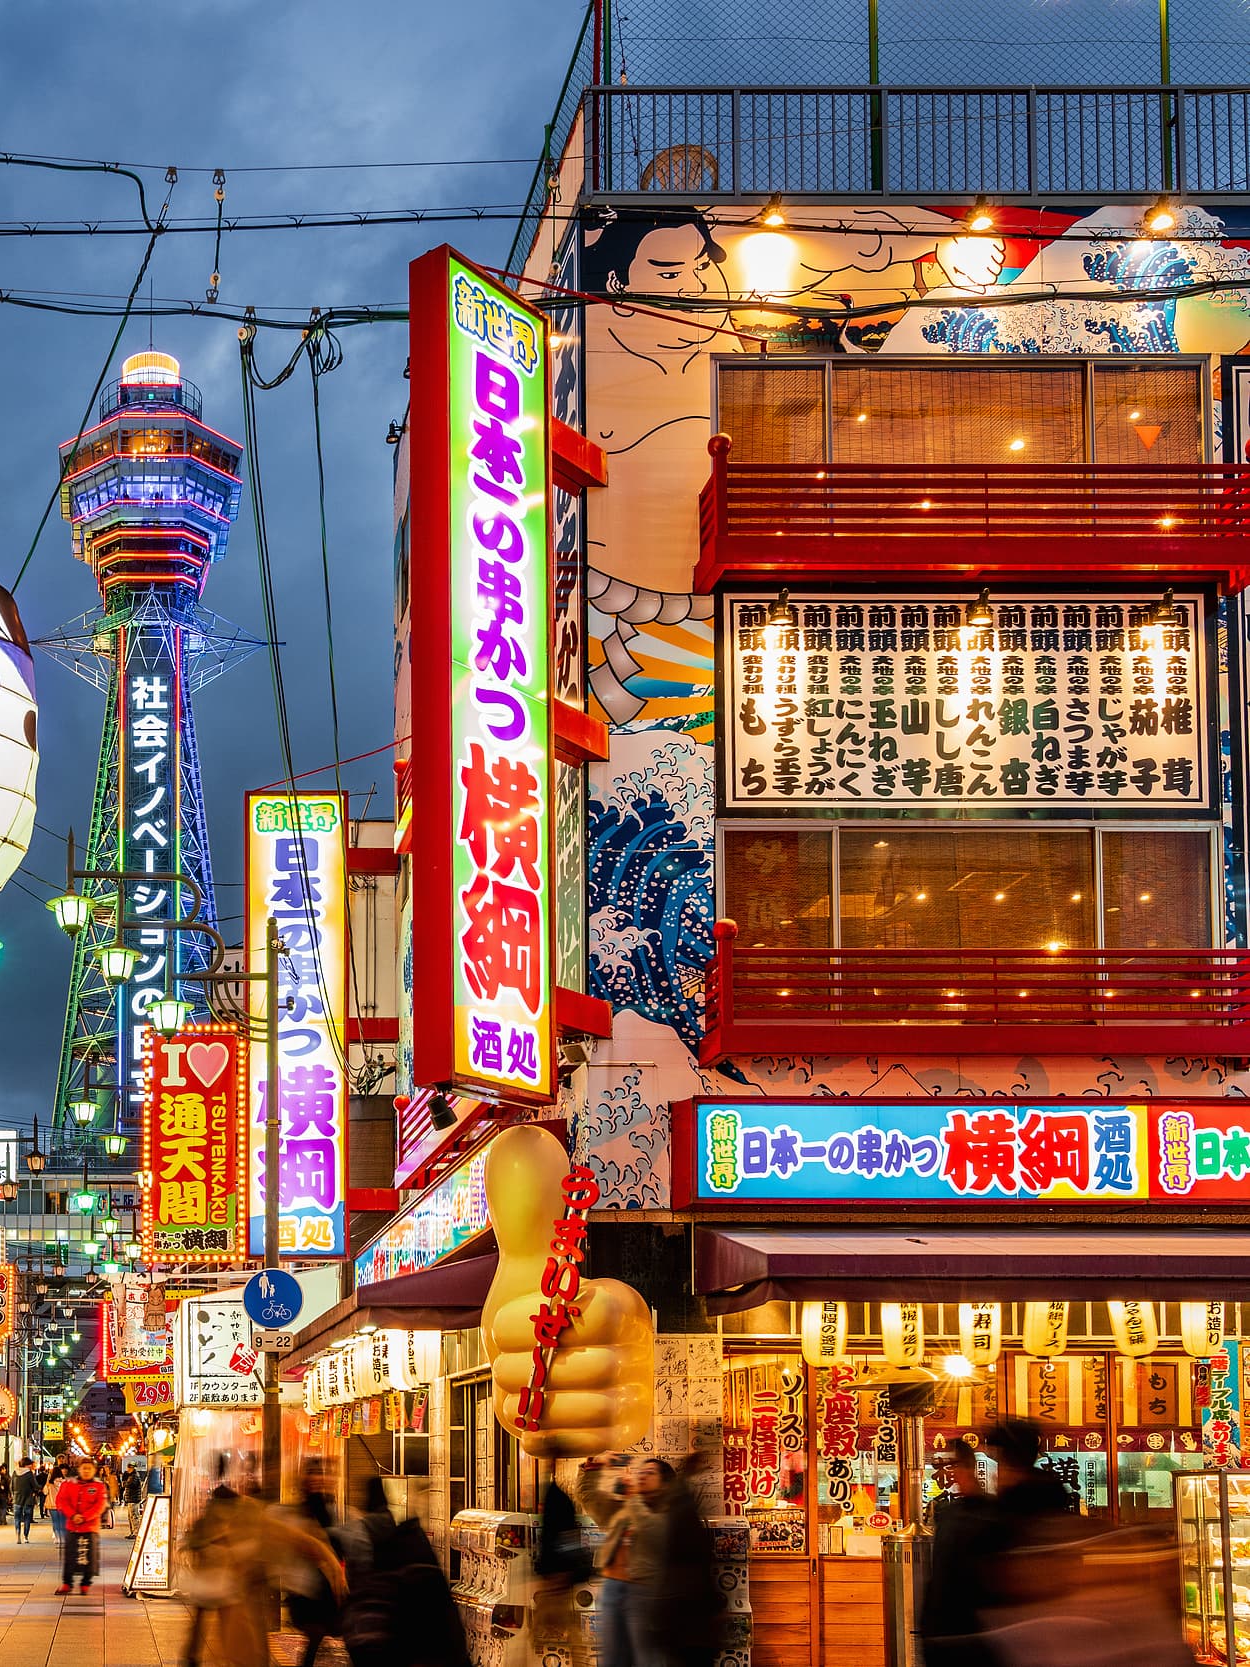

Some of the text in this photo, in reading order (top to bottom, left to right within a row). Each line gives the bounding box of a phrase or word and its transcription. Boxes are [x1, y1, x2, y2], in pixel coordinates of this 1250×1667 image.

[455, 276, 538, 371] 新世界
[471, 352, 528, 741] 日本一の串かつ
[256, 802, 337, 832] 新世界
[460, 742, 541, 1015] 横綱
[160, 1043, 187, 1087] I
[472, 1015, 537, 1080] 酒処
[159, 1092, 207, 1225] 通天閣
[210, 1092, 227, 1224] TSUTENKAKU
[710, 1114, 738, 1189] 新世界
[742, 1128, 937, 1177] 日本一の串かつ
[945, 1112, 1089, 1193] 横綱
[1095, 1115, 1134, 1190] 酒処
[1163, 1115, 1191, 1190] 新世界
[182, 1229, 228, 1251] 横綱
[201, 1393, 258, 1402] 座敷あります
[202, 1382, 258, 1391] カウンター席
[780, 1375, 803, 1448] ソースの
[751, 1391, 779, 1496] 二度漬け
